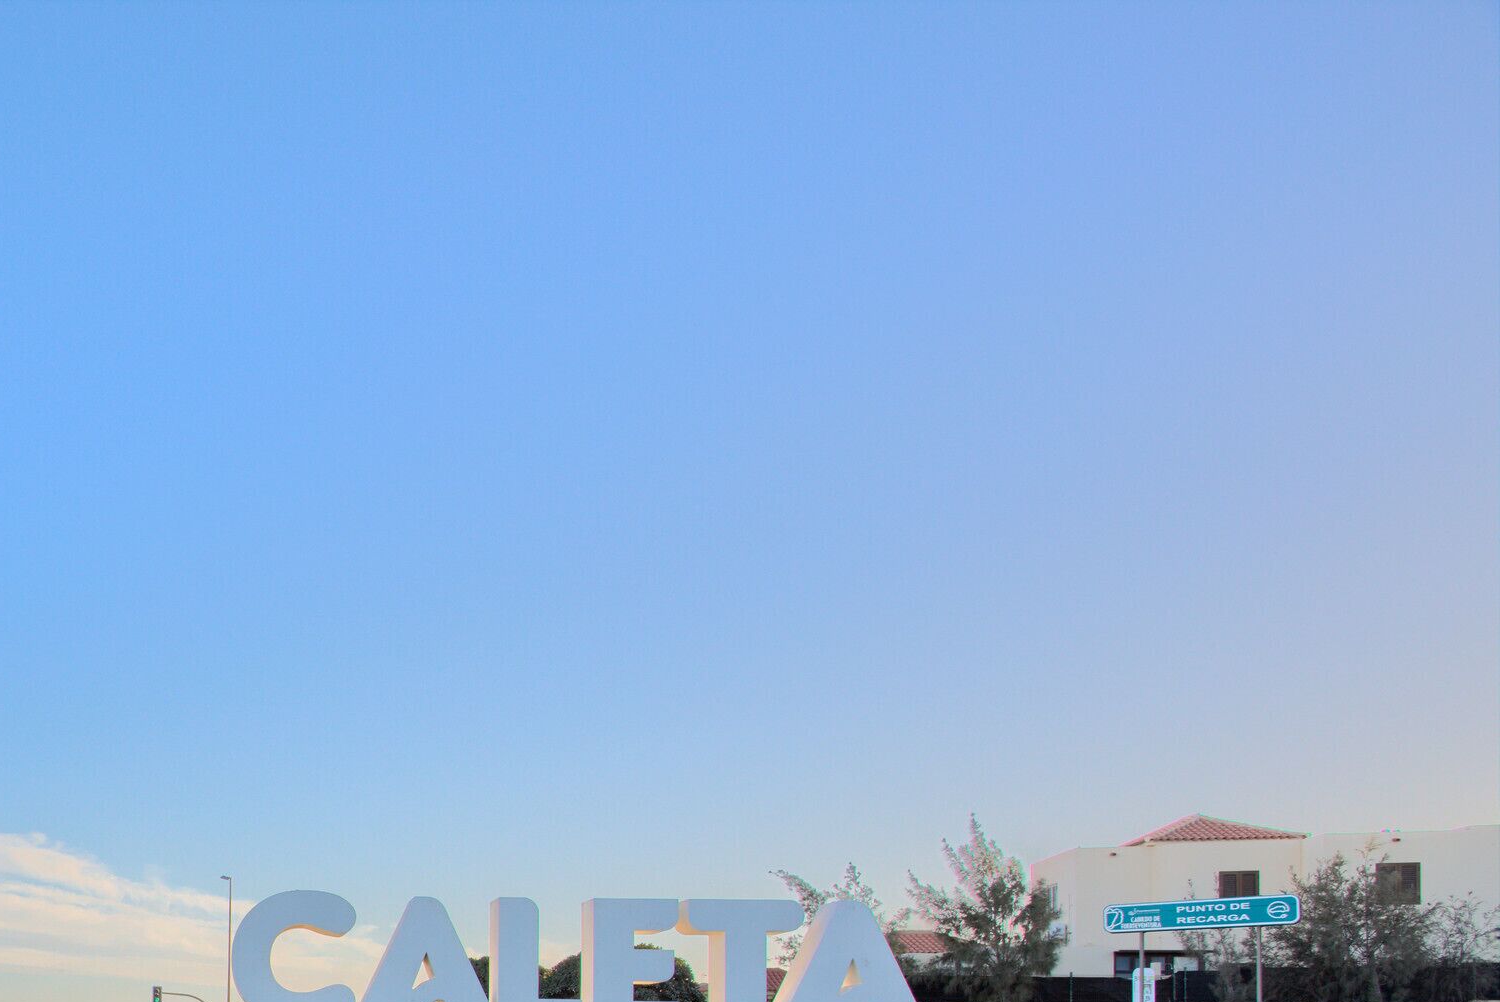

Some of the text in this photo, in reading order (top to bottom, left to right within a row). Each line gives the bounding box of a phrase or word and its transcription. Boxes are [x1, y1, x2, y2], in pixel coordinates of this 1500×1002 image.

[1176, 902, 1251, 913] PUNTO DE
[1176, 914, 1251, 924] RECARGA
